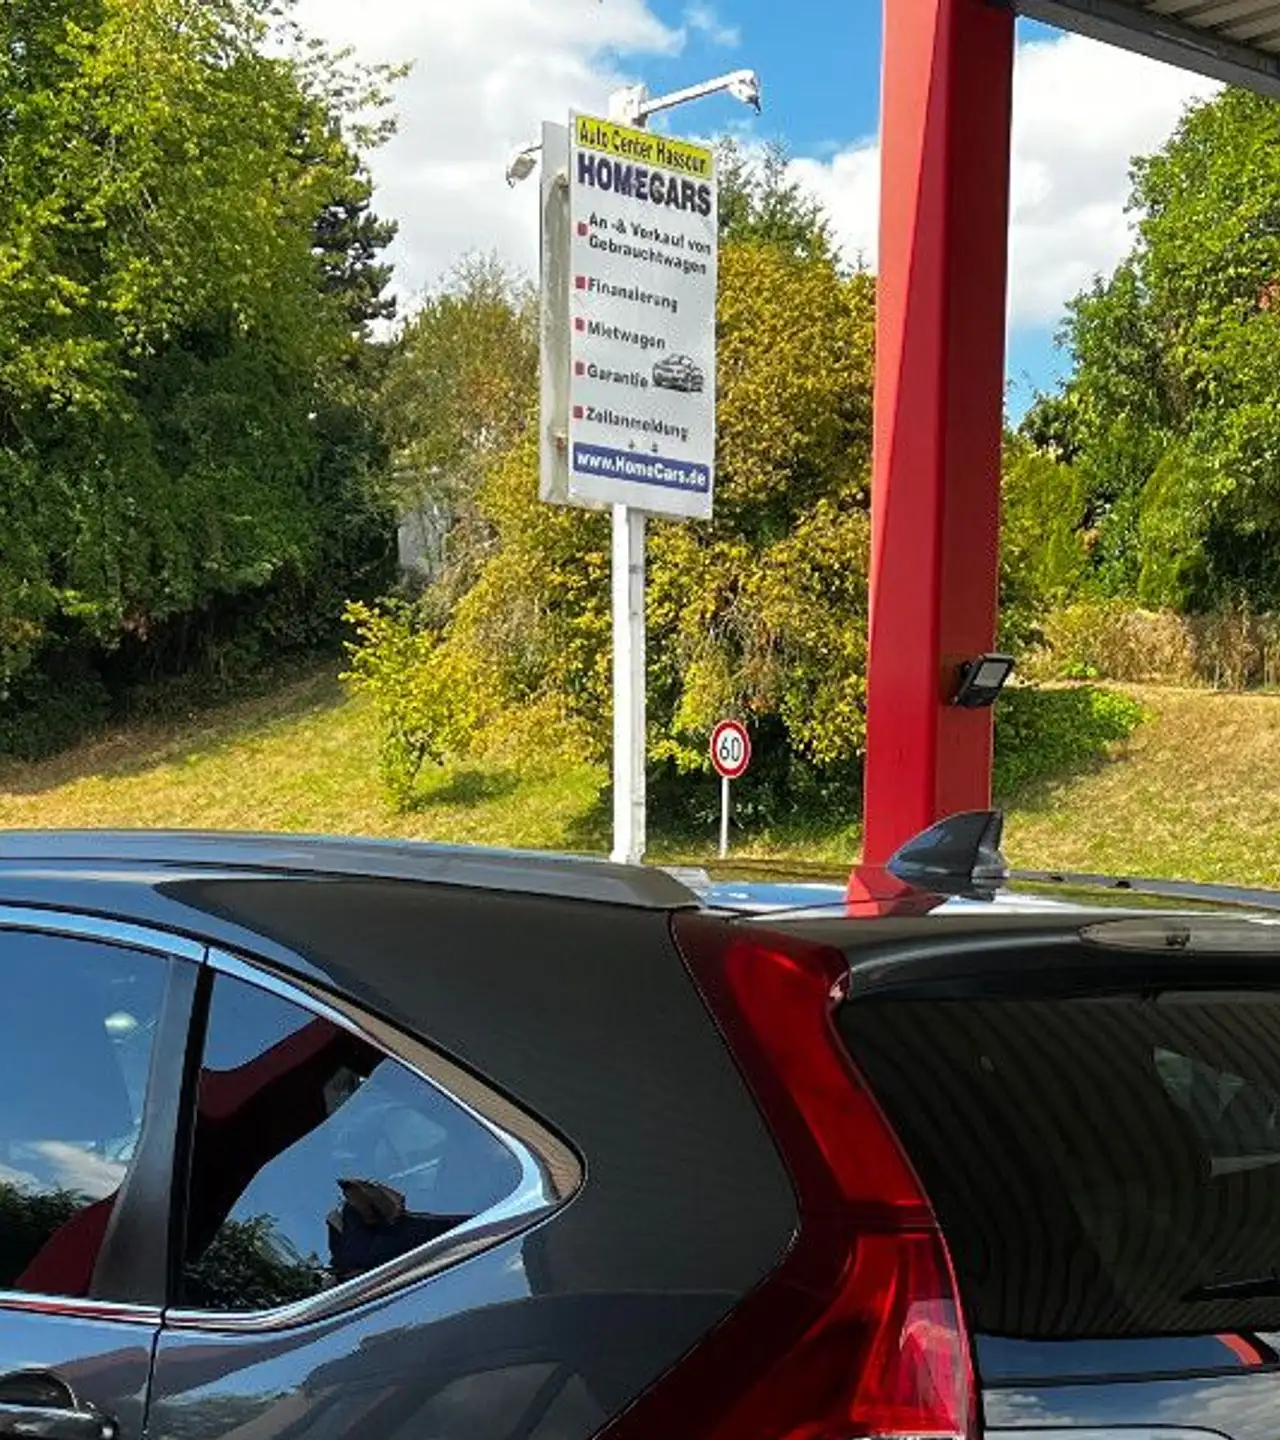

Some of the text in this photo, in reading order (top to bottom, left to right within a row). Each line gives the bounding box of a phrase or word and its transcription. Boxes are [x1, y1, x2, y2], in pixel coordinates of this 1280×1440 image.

[579, 120, 608, 149] Auto
[611, 129, 653, 160] Center
[577, 151, 712, 218] HOMECARS
[589, 211, 608, 230] An
[630, 221, 685, 249] Verkauf
[688, 239, 712, 256] von
[589, 234, 707, 275] Gebrauchtwagen
[588, 276, 678, 314] Finanzierung
[587, 320, 666, 350] Mietwagen
[587, 363, 649, 389] Garantie
[585, 405, 689, 442] Zollanmeldung
[575, 450, 707, 486] www.HomeCars.de
[719, 737, 742, 762] 60
